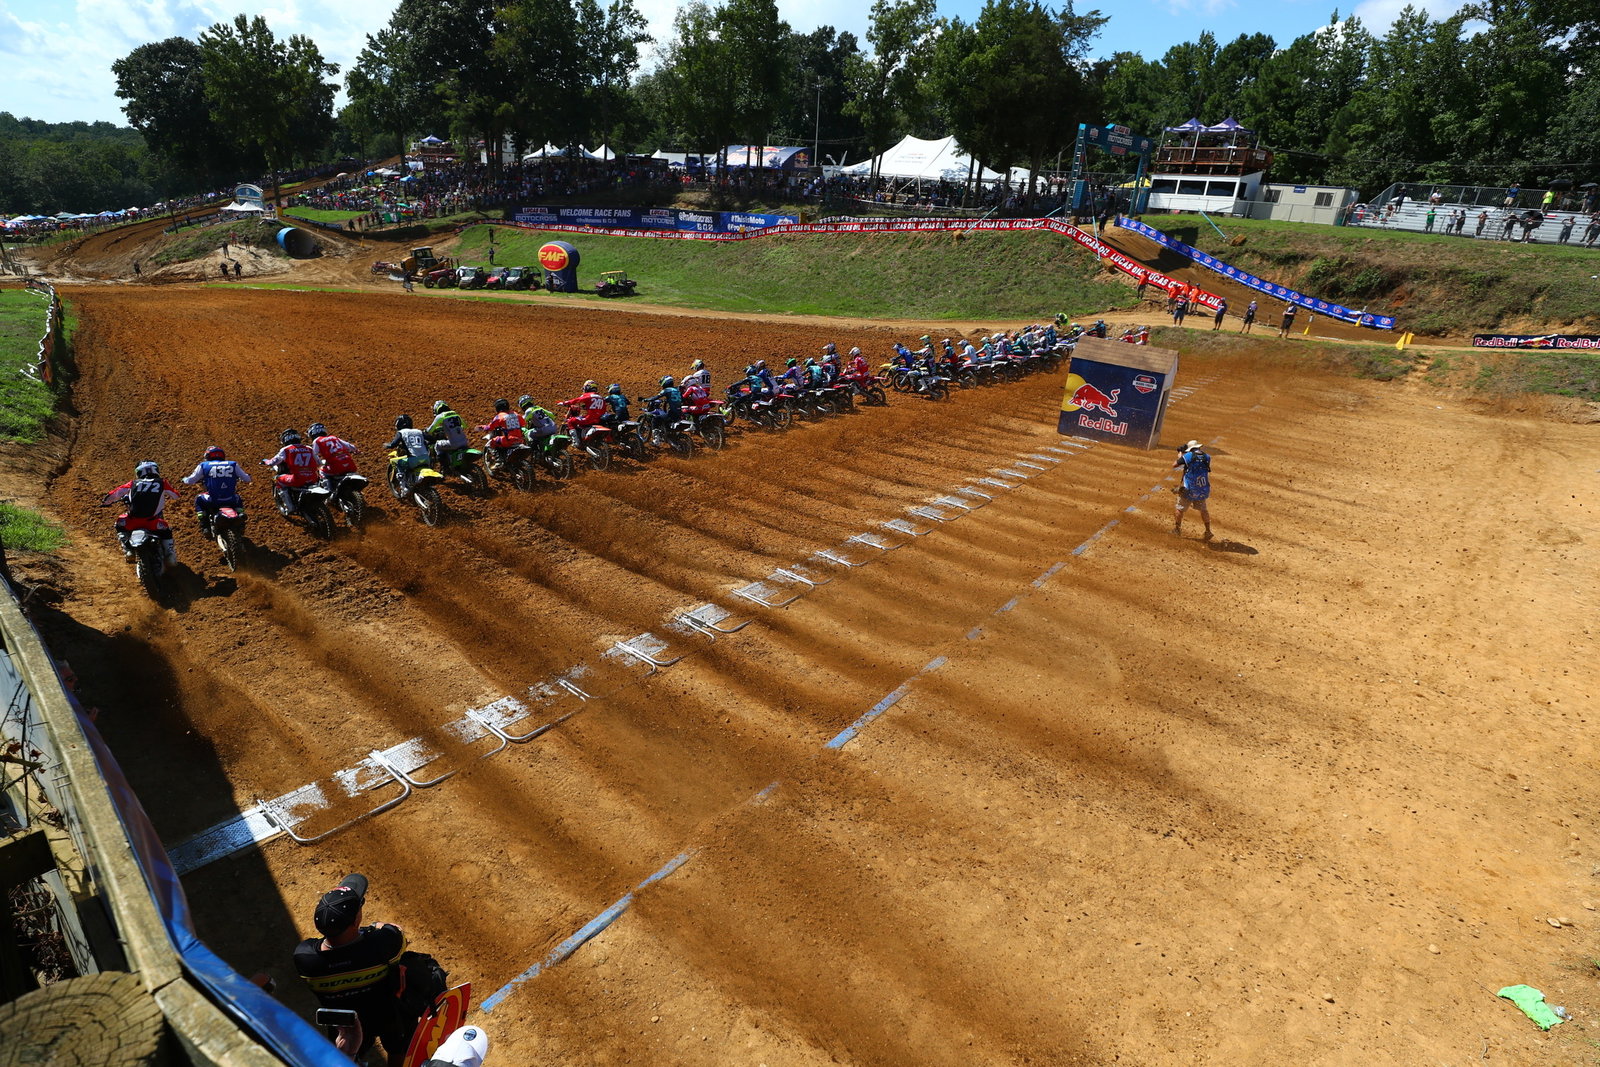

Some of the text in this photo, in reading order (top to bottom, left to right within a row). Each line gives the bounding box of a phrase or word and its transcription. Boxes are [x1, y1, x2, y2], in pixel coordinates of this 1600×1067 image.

[1046, 220, 1067, 232] LUCAS
[1067, 227, 1078, 237] OIL
[1078, 234, 1110, 256] LUCAS OIL
[540, 252, 564, 261] FMF
[1110, 254, 1144, 276] LUCAS OIL
[1146, 271, 1168, 286] UCAS
[1207, 296, 1222, 306] OIL
[1474, 337, 1518, 347] Red Bull
[1556, 338, 1600, 348] Red Bul
[702, 375, 710, 384] 18
[1079, 414, 1128, 436] Red Bull
[294, 453, 311, 466] 47
[209, 466, 233, 478] 432
[136, 481, 160, 493] 172
[1196, 476, 1206, 487] 40
[319, 968, 388, 987] DUNLOP
